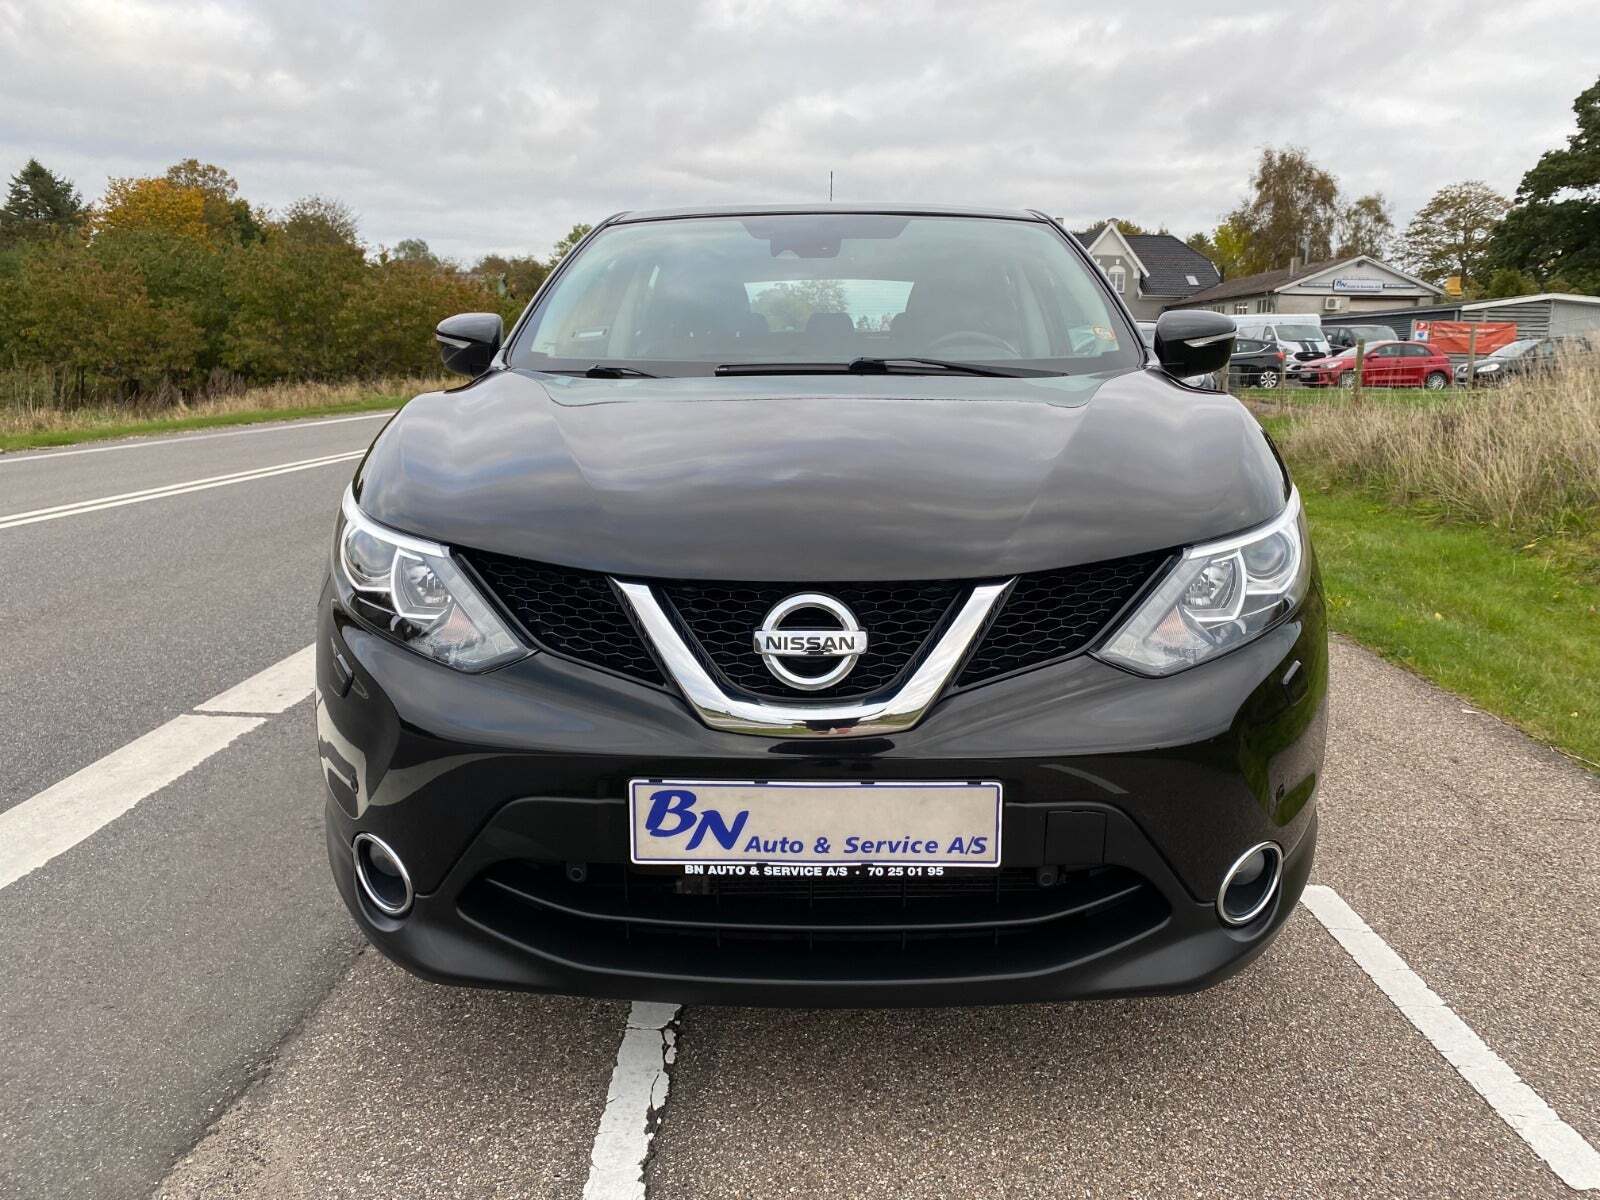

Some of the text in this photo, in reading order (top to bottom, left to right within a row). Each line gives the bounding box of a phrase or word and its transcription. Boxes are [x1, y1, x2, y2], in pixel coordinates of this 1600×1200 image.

[765, 636, 855, 651] NISSAN
[645, 789, 988, 854] BN Auto & Service A/S
[684, 865, 944, 877] BN AUTO & SERVICE A/S 70 25 01 95
